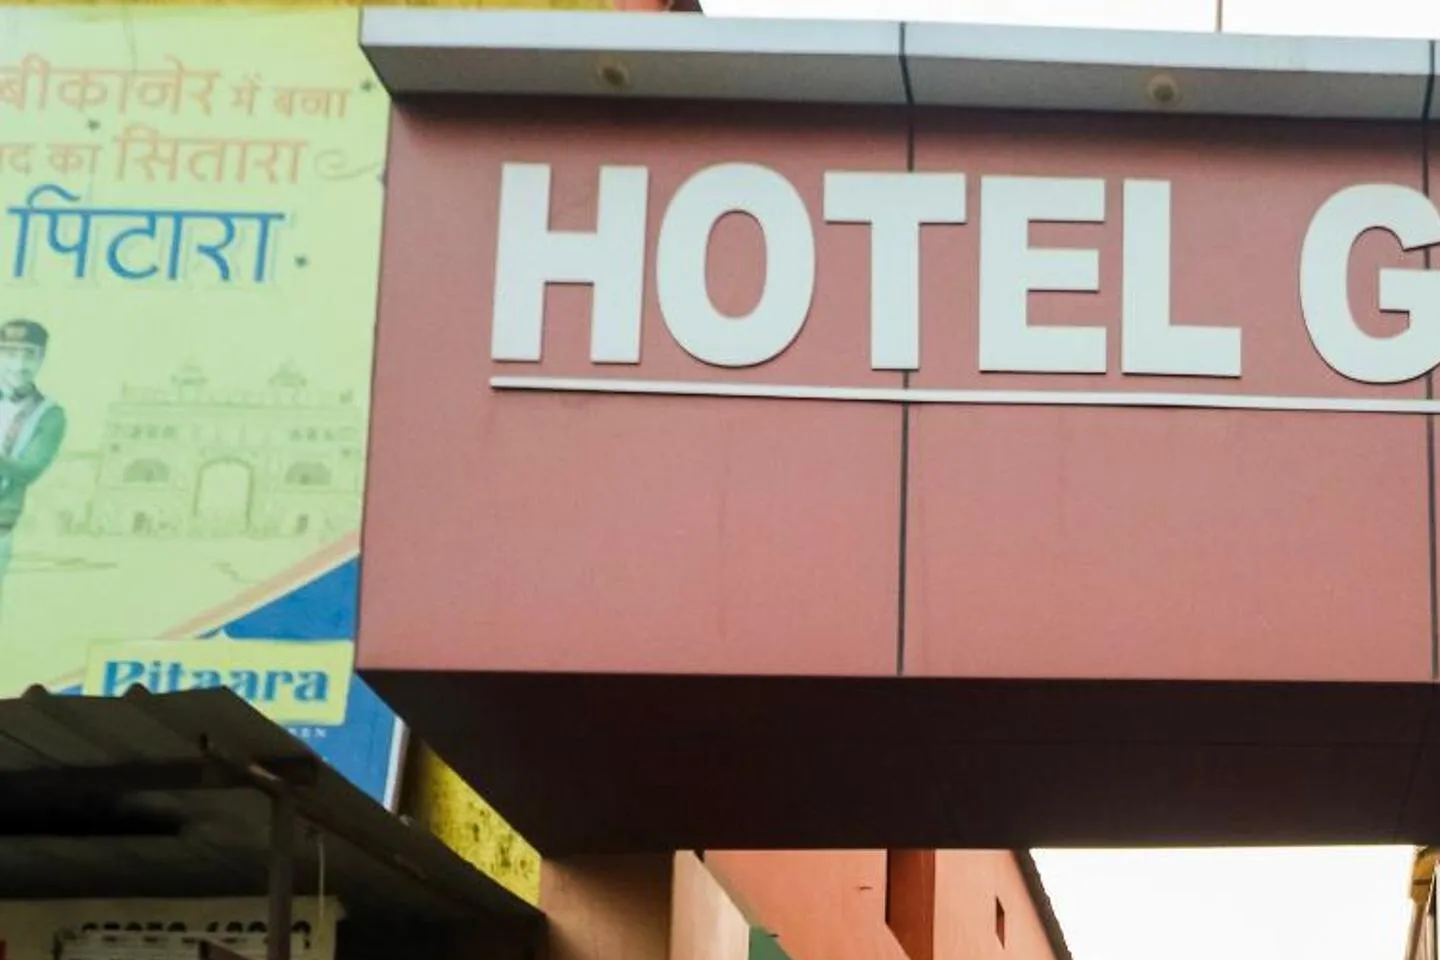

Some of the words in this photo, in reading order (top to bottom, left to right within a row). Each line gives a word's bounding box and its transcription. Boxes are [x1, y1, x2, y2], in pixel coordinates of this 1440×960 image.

[272, 87, 352, 119] बना
[45, 142, 103, 174] का
[112, 123, 308, 184] सितारा
[7, 184, 285, 283] पिटारा
[491, 162, 1242, 378] HOTEL
